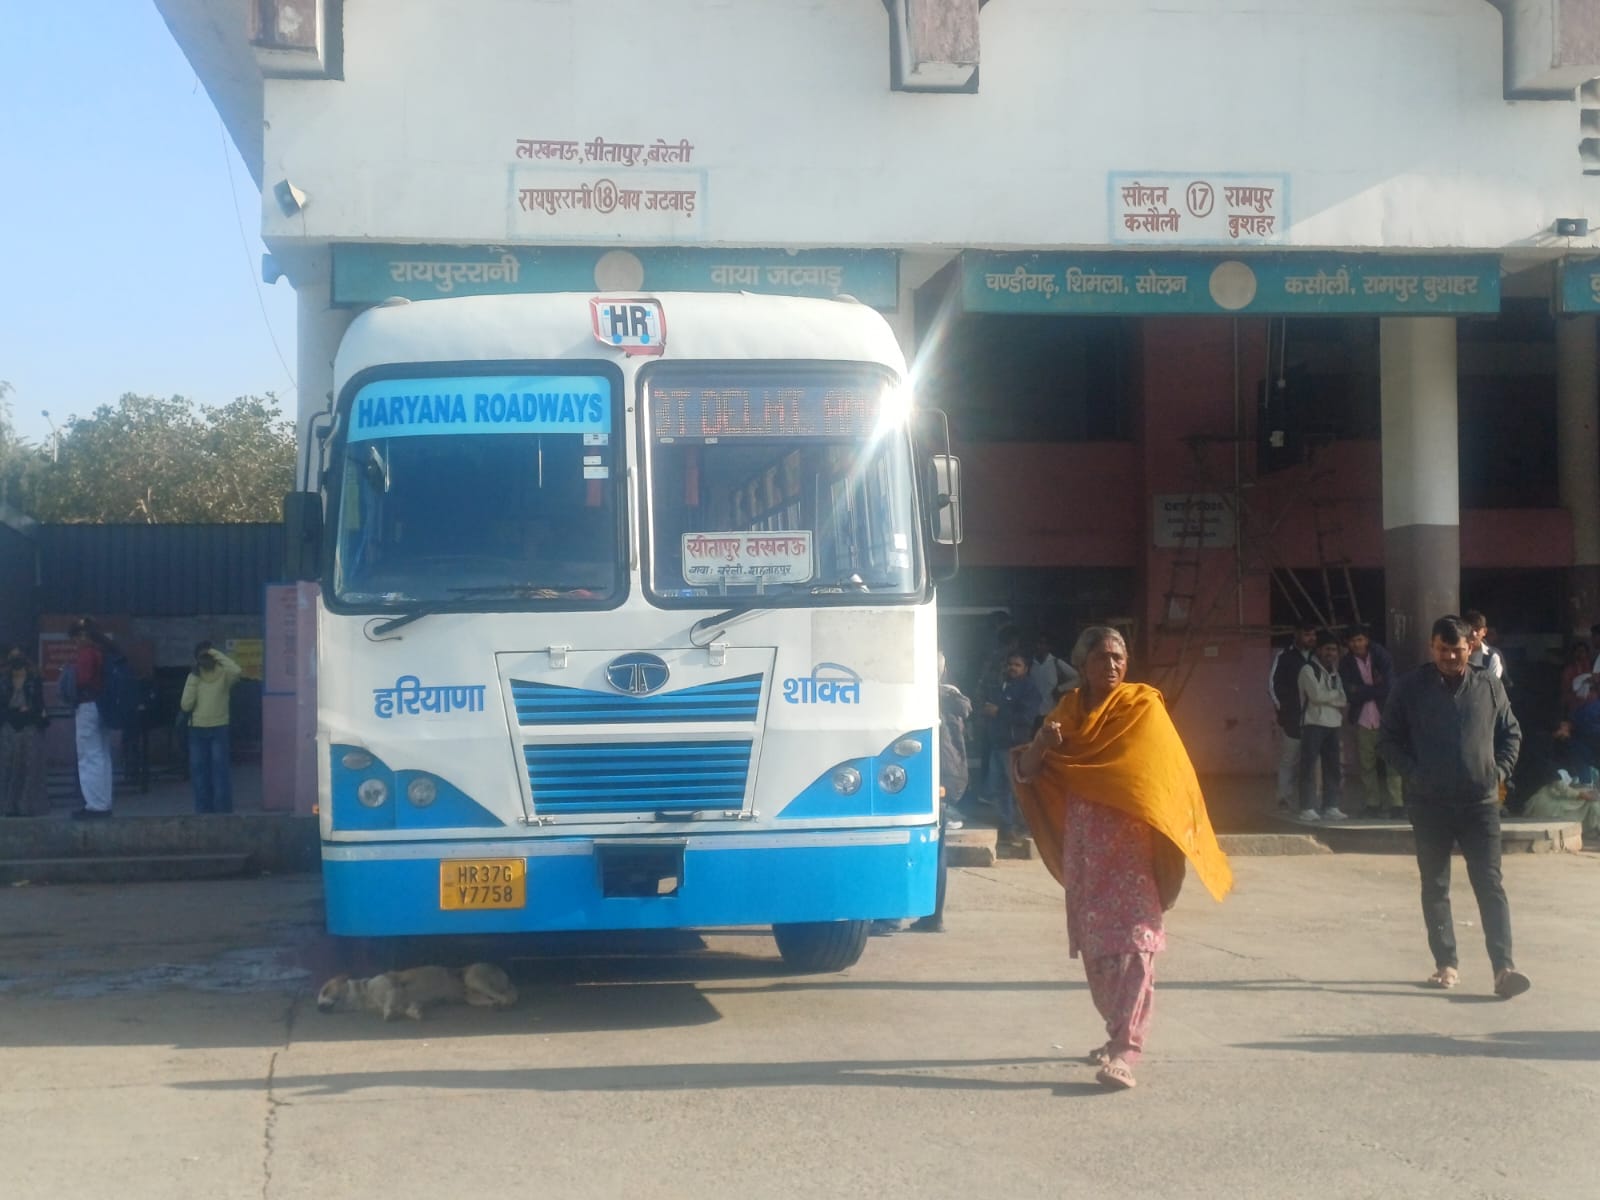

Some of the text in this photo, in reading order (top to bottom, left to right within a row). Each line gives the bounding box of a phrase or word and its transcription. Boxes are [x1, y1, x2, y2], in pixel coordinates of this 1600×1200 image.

[1191, 188, 1209, 211] 17
[1224, 187, 1274, 213] रामपुर
[1124, 207, 1275, 239] कसौली बुशहर
[710, 265, 760, 286] वाया
[1363, 275, 1419, 301] रामपुर
[609, 305, 649, 337] HR
[357, 392, 602, 428] HARYANA ROADWAYS
[746, 537, 806, 557] लखनऊ
[373, 662, 862, 718] हरियाणा शक्ति
[458, 865, 512, 883] HR37G
